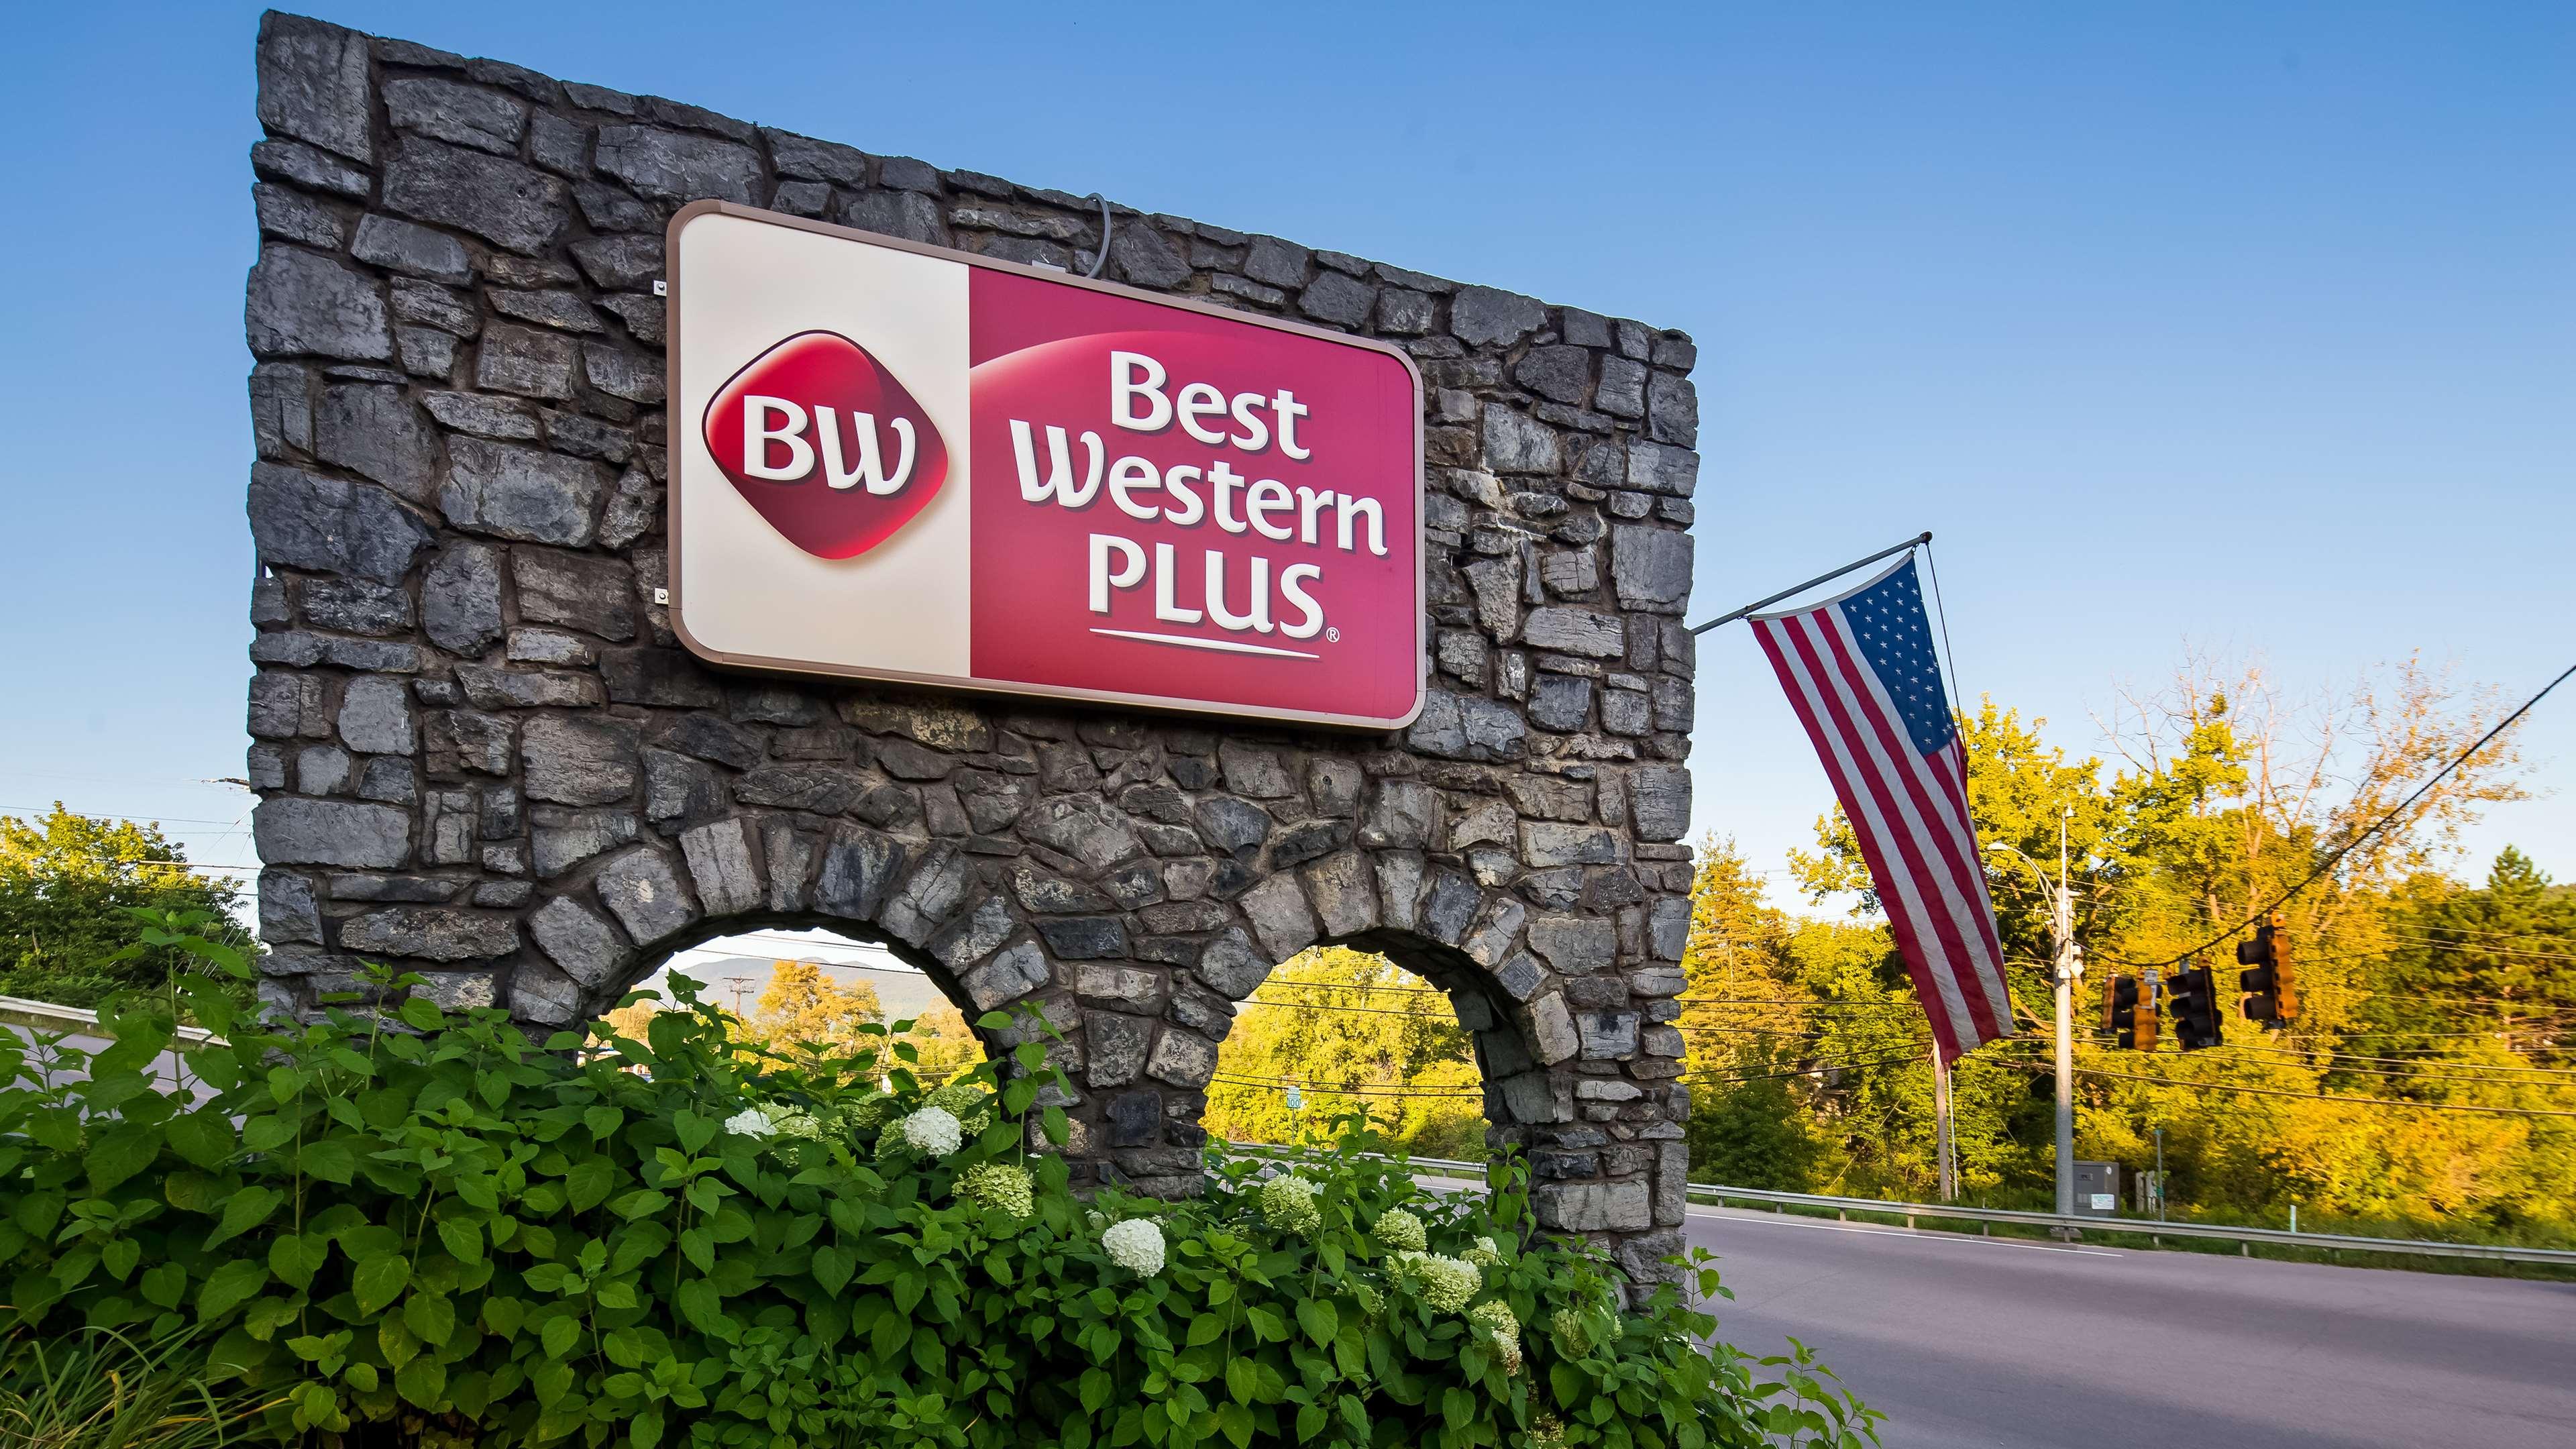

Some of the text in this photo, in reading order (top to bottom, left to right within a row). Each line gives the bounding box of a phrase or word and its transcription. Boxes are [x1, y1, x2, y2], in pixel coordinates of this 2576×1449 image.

[744, 394, 916, 495] BW
[1111, 350, 1310, 460] Best
[1009, 419, 1388, 556] Western
